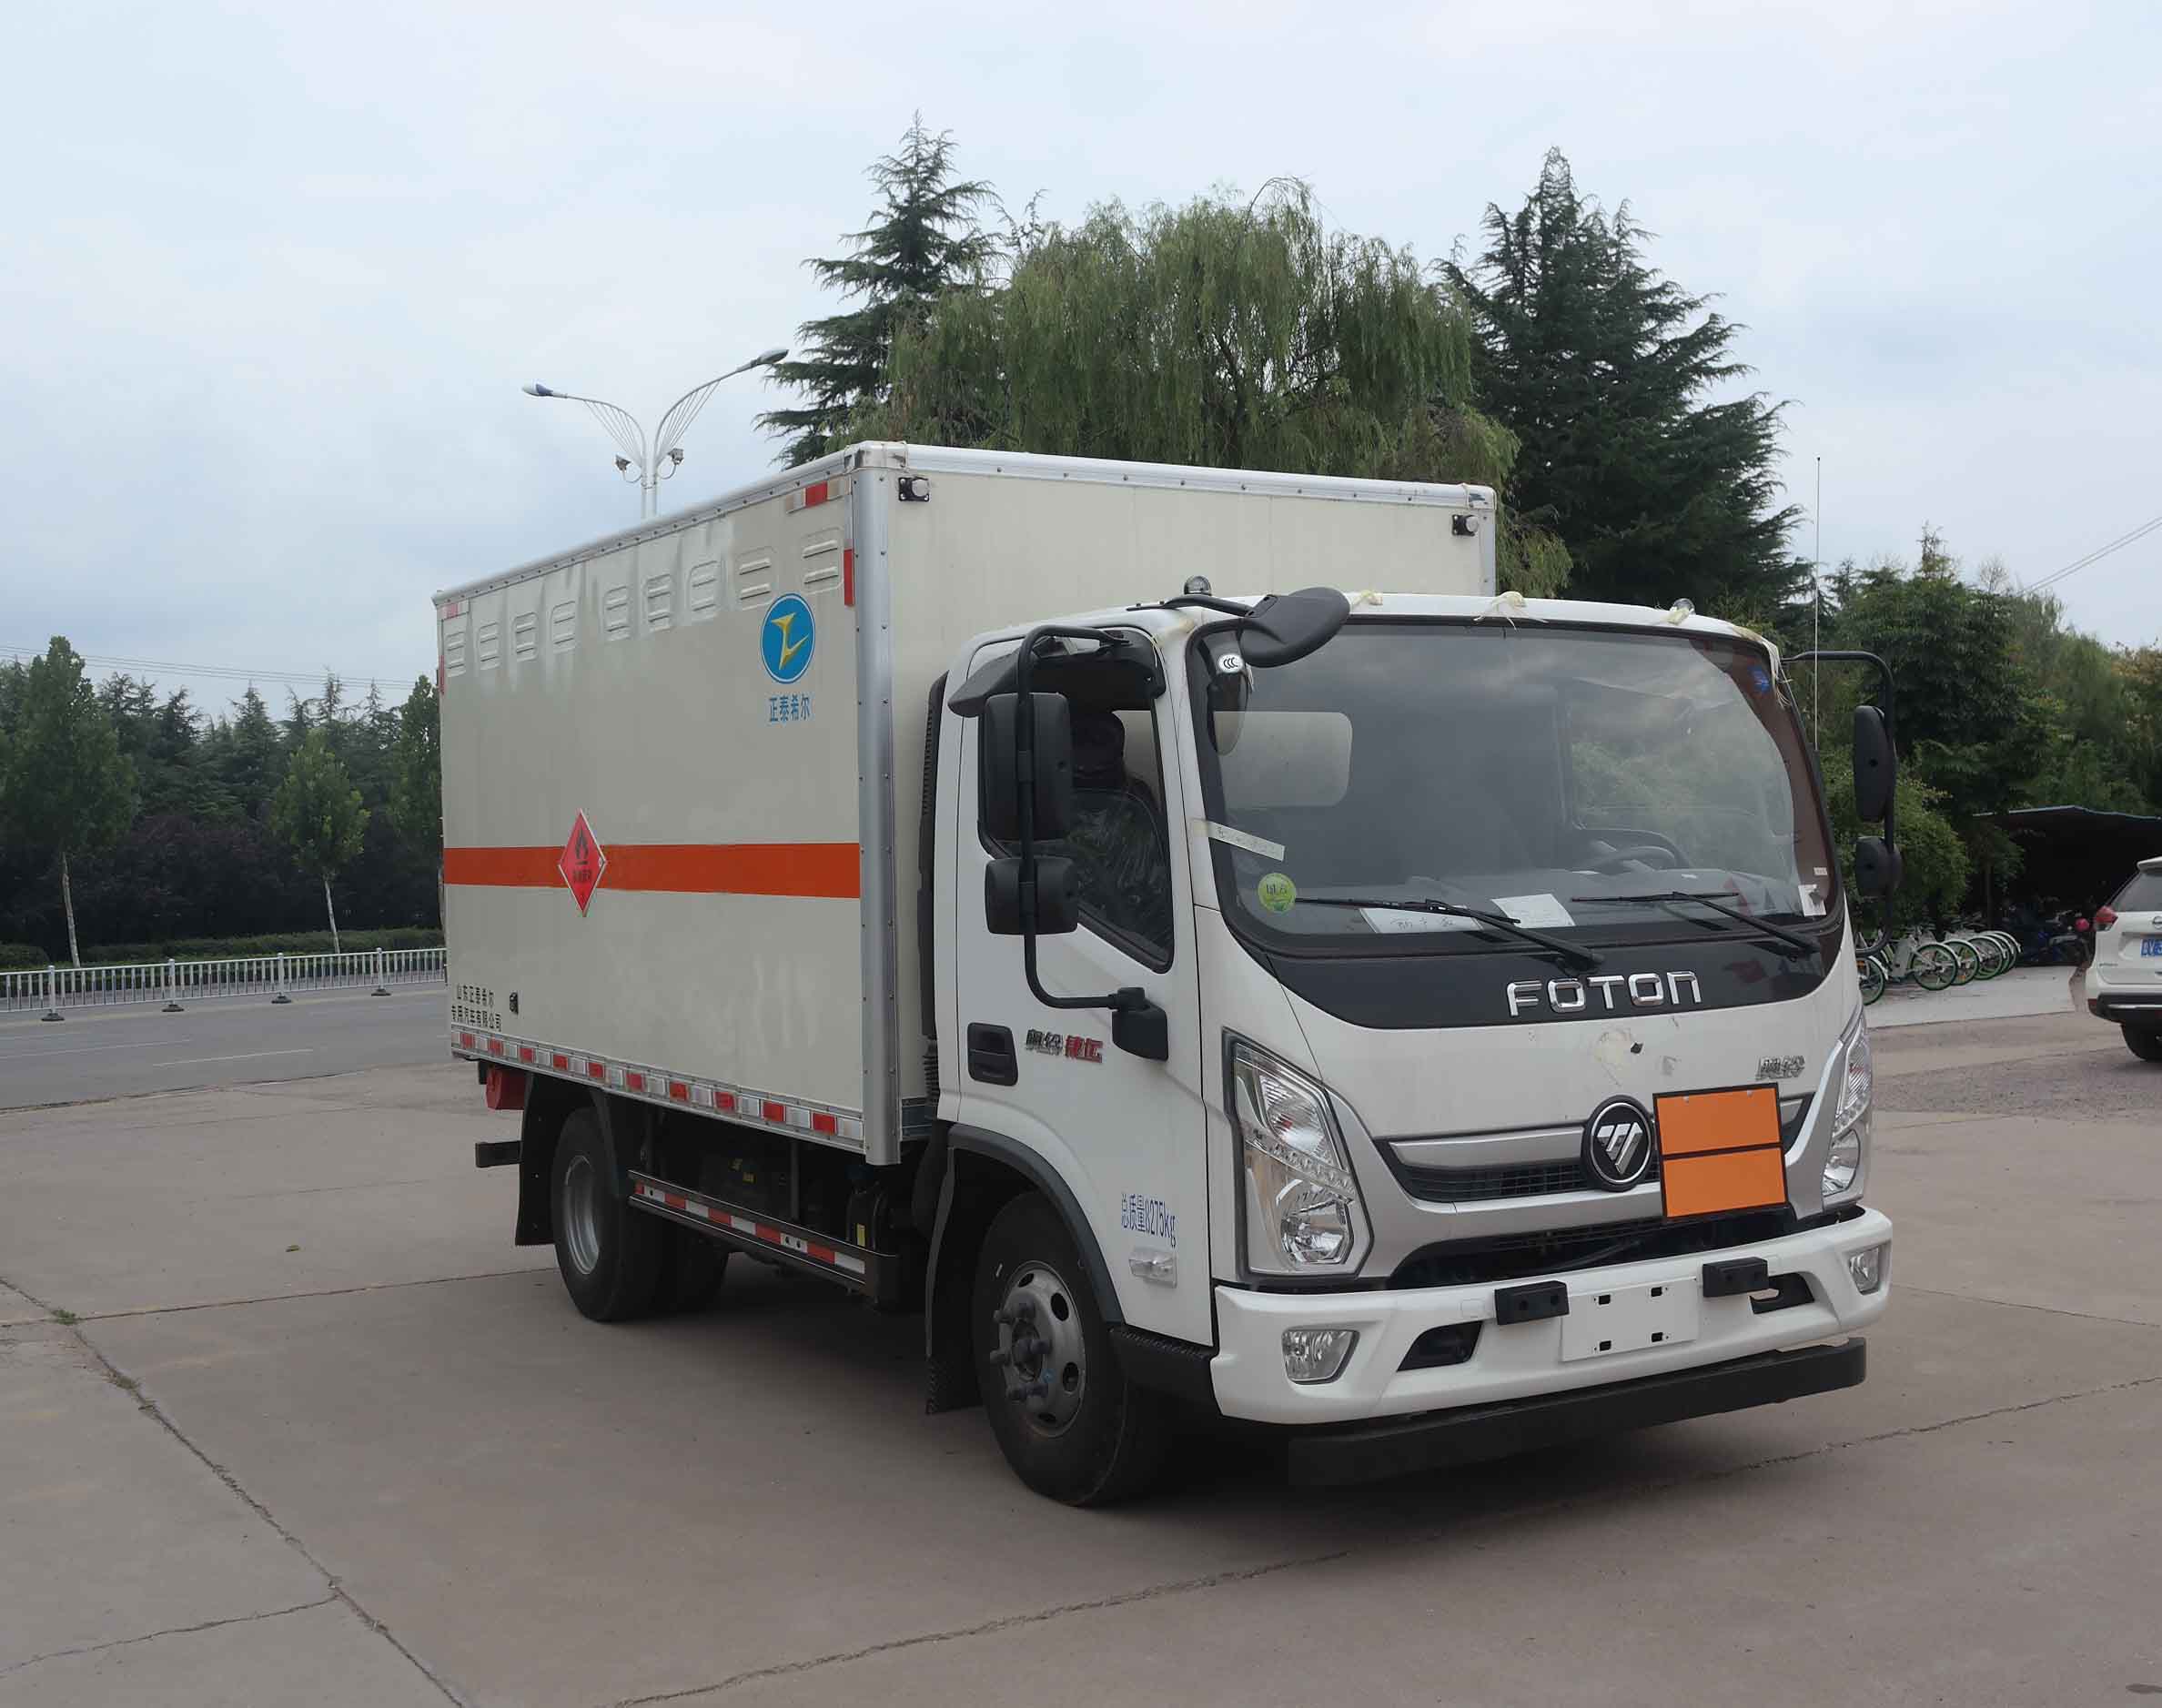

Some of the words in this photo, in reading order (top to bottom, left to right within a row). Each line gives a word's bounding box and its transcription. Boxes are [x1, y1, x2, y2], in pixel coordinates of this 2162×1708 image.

[769, 692, 811, 722] 正泰希尔
[1506, 970, 1702, 1016] FOTON
